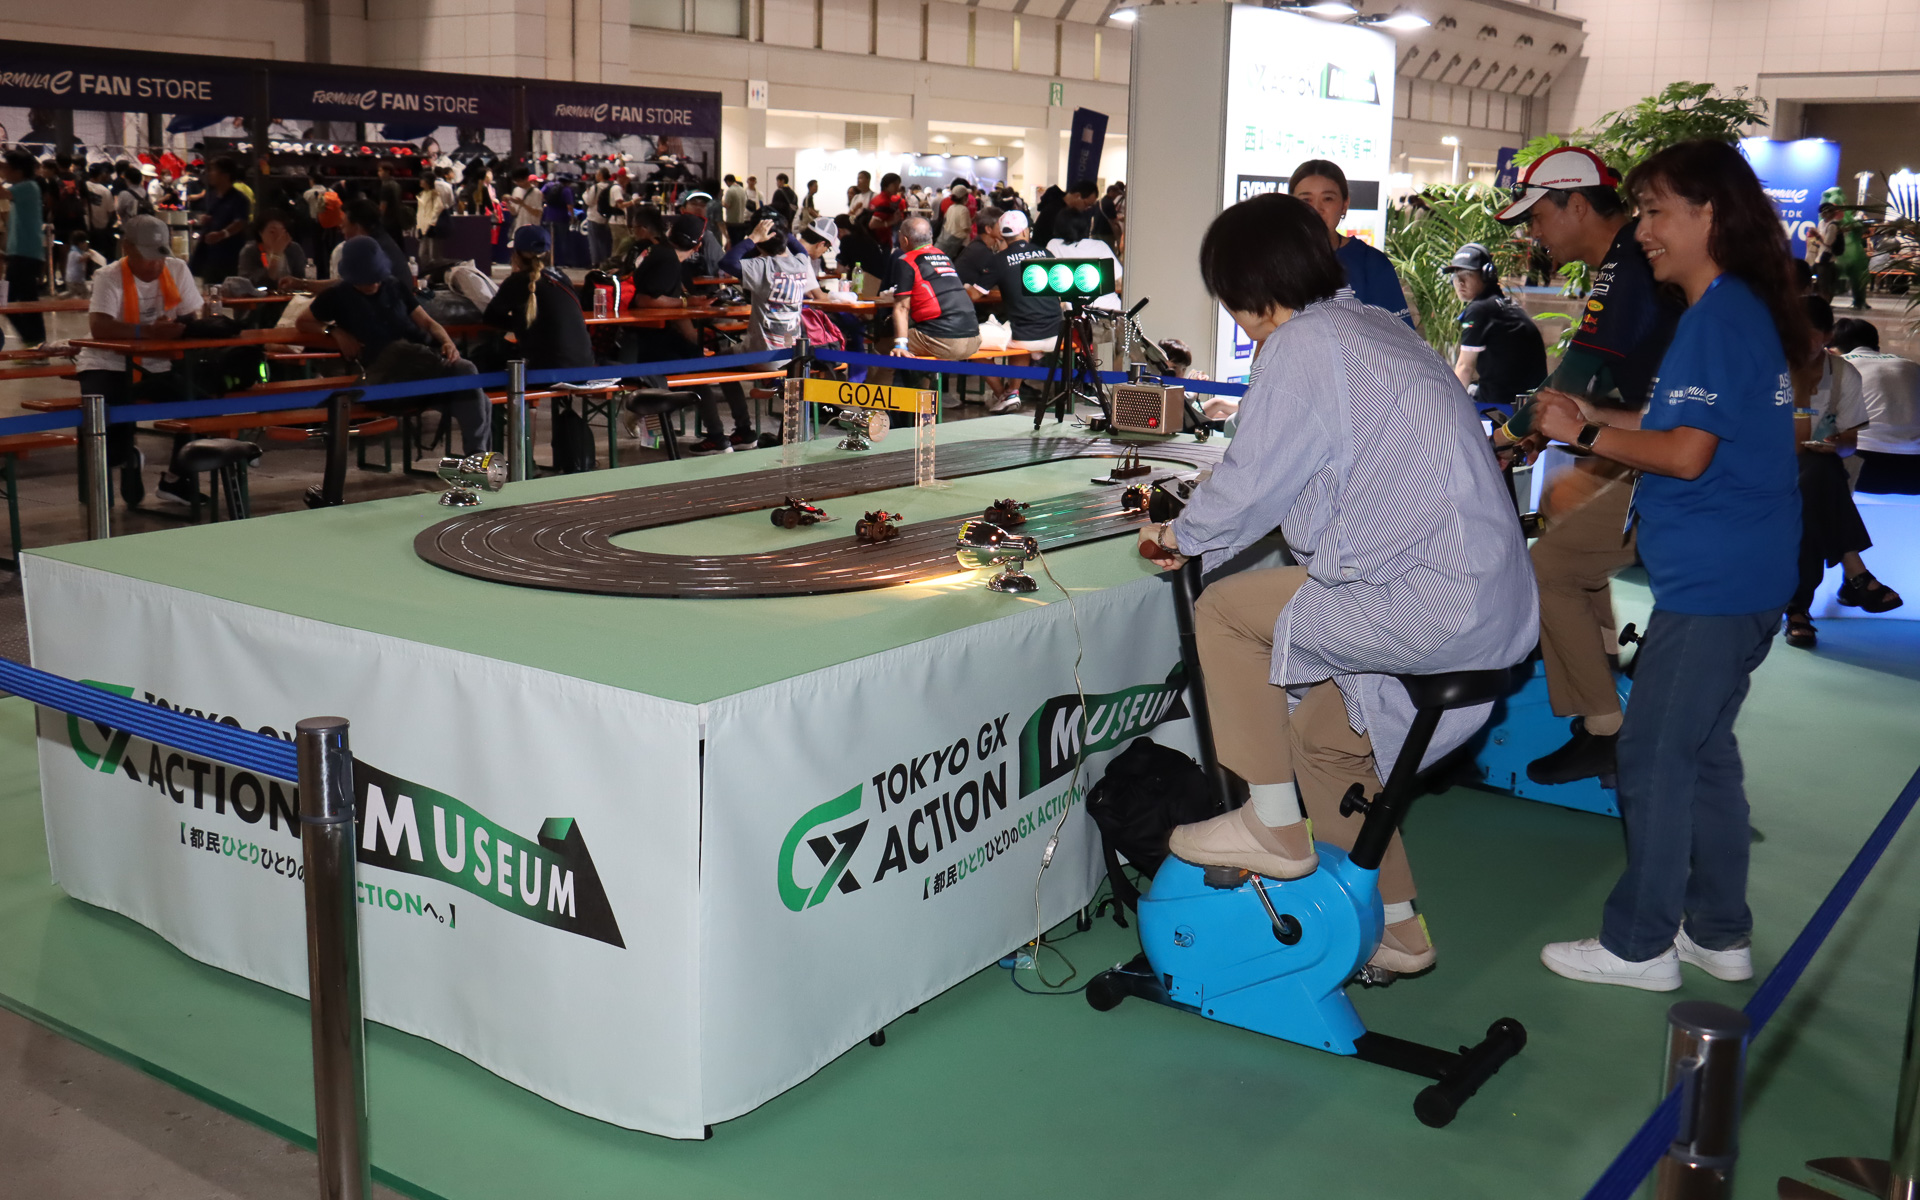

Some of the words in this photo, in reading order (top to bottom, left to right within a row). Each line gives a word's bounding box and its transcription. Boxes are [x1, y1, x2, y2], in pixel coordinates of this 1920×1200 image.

[80, 74, 131, 96] FAN
[138, 78, 212, 100] STORE
[381, 93, 419, 111] FAN
[423, 95, 479, 114] STORE
[611, 106, 642, 123] FAN
[646, 108, 692, 125] STORE
[1781, 209, 1803, 218] TDK
[1007, 250, 1047, 263] NISSAN
[838, 383, 900, 409] GOAL
[1050, 689, 1178, 769] MUSEUM
[872, 737, 969, 813] TOKYO
[977, 712, 1010, 761] GX
[148, 743, 301, 839] ACTION
[873, 761, 1007, 883] ACTION
[362, 782, 576, 918] MUSEUM
